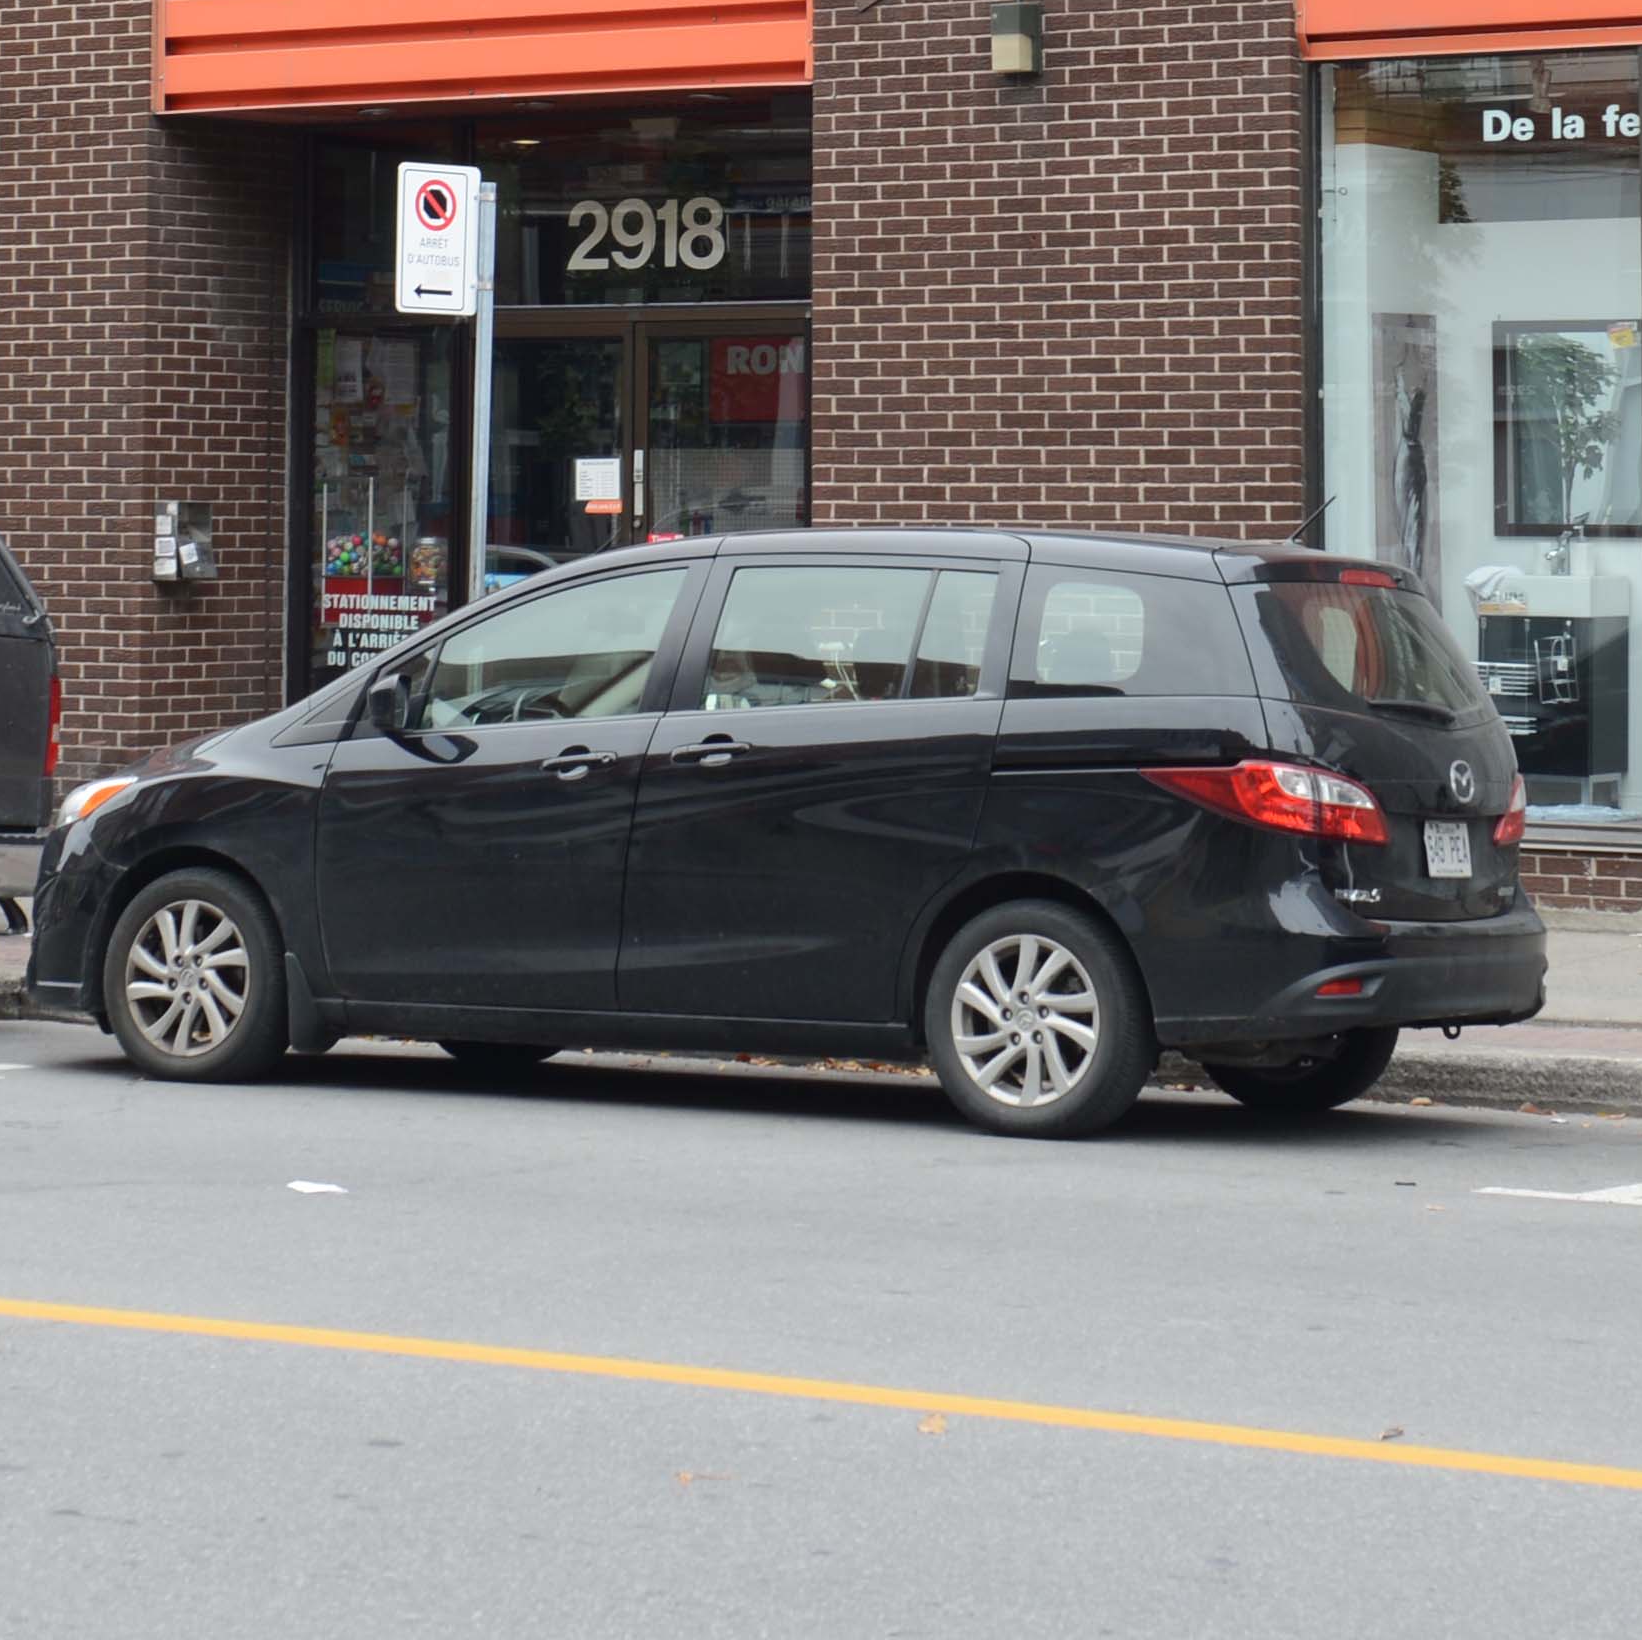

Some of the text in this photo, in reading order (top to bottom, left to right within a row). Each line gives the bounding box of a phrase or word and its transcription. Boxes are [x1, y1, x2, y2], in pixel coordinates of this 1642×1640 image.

[1482, 109, 1535, 143] De
[1552, 104, 1586, 140] la
[566, 197, 726, 271] 2918
[322, 594, 437, 612] STATIONNEMENT
[338, 613, 420, 631] DISPONIBLE
[332, 628, 343, 648] À
[327, 651, 347, 667] DU
